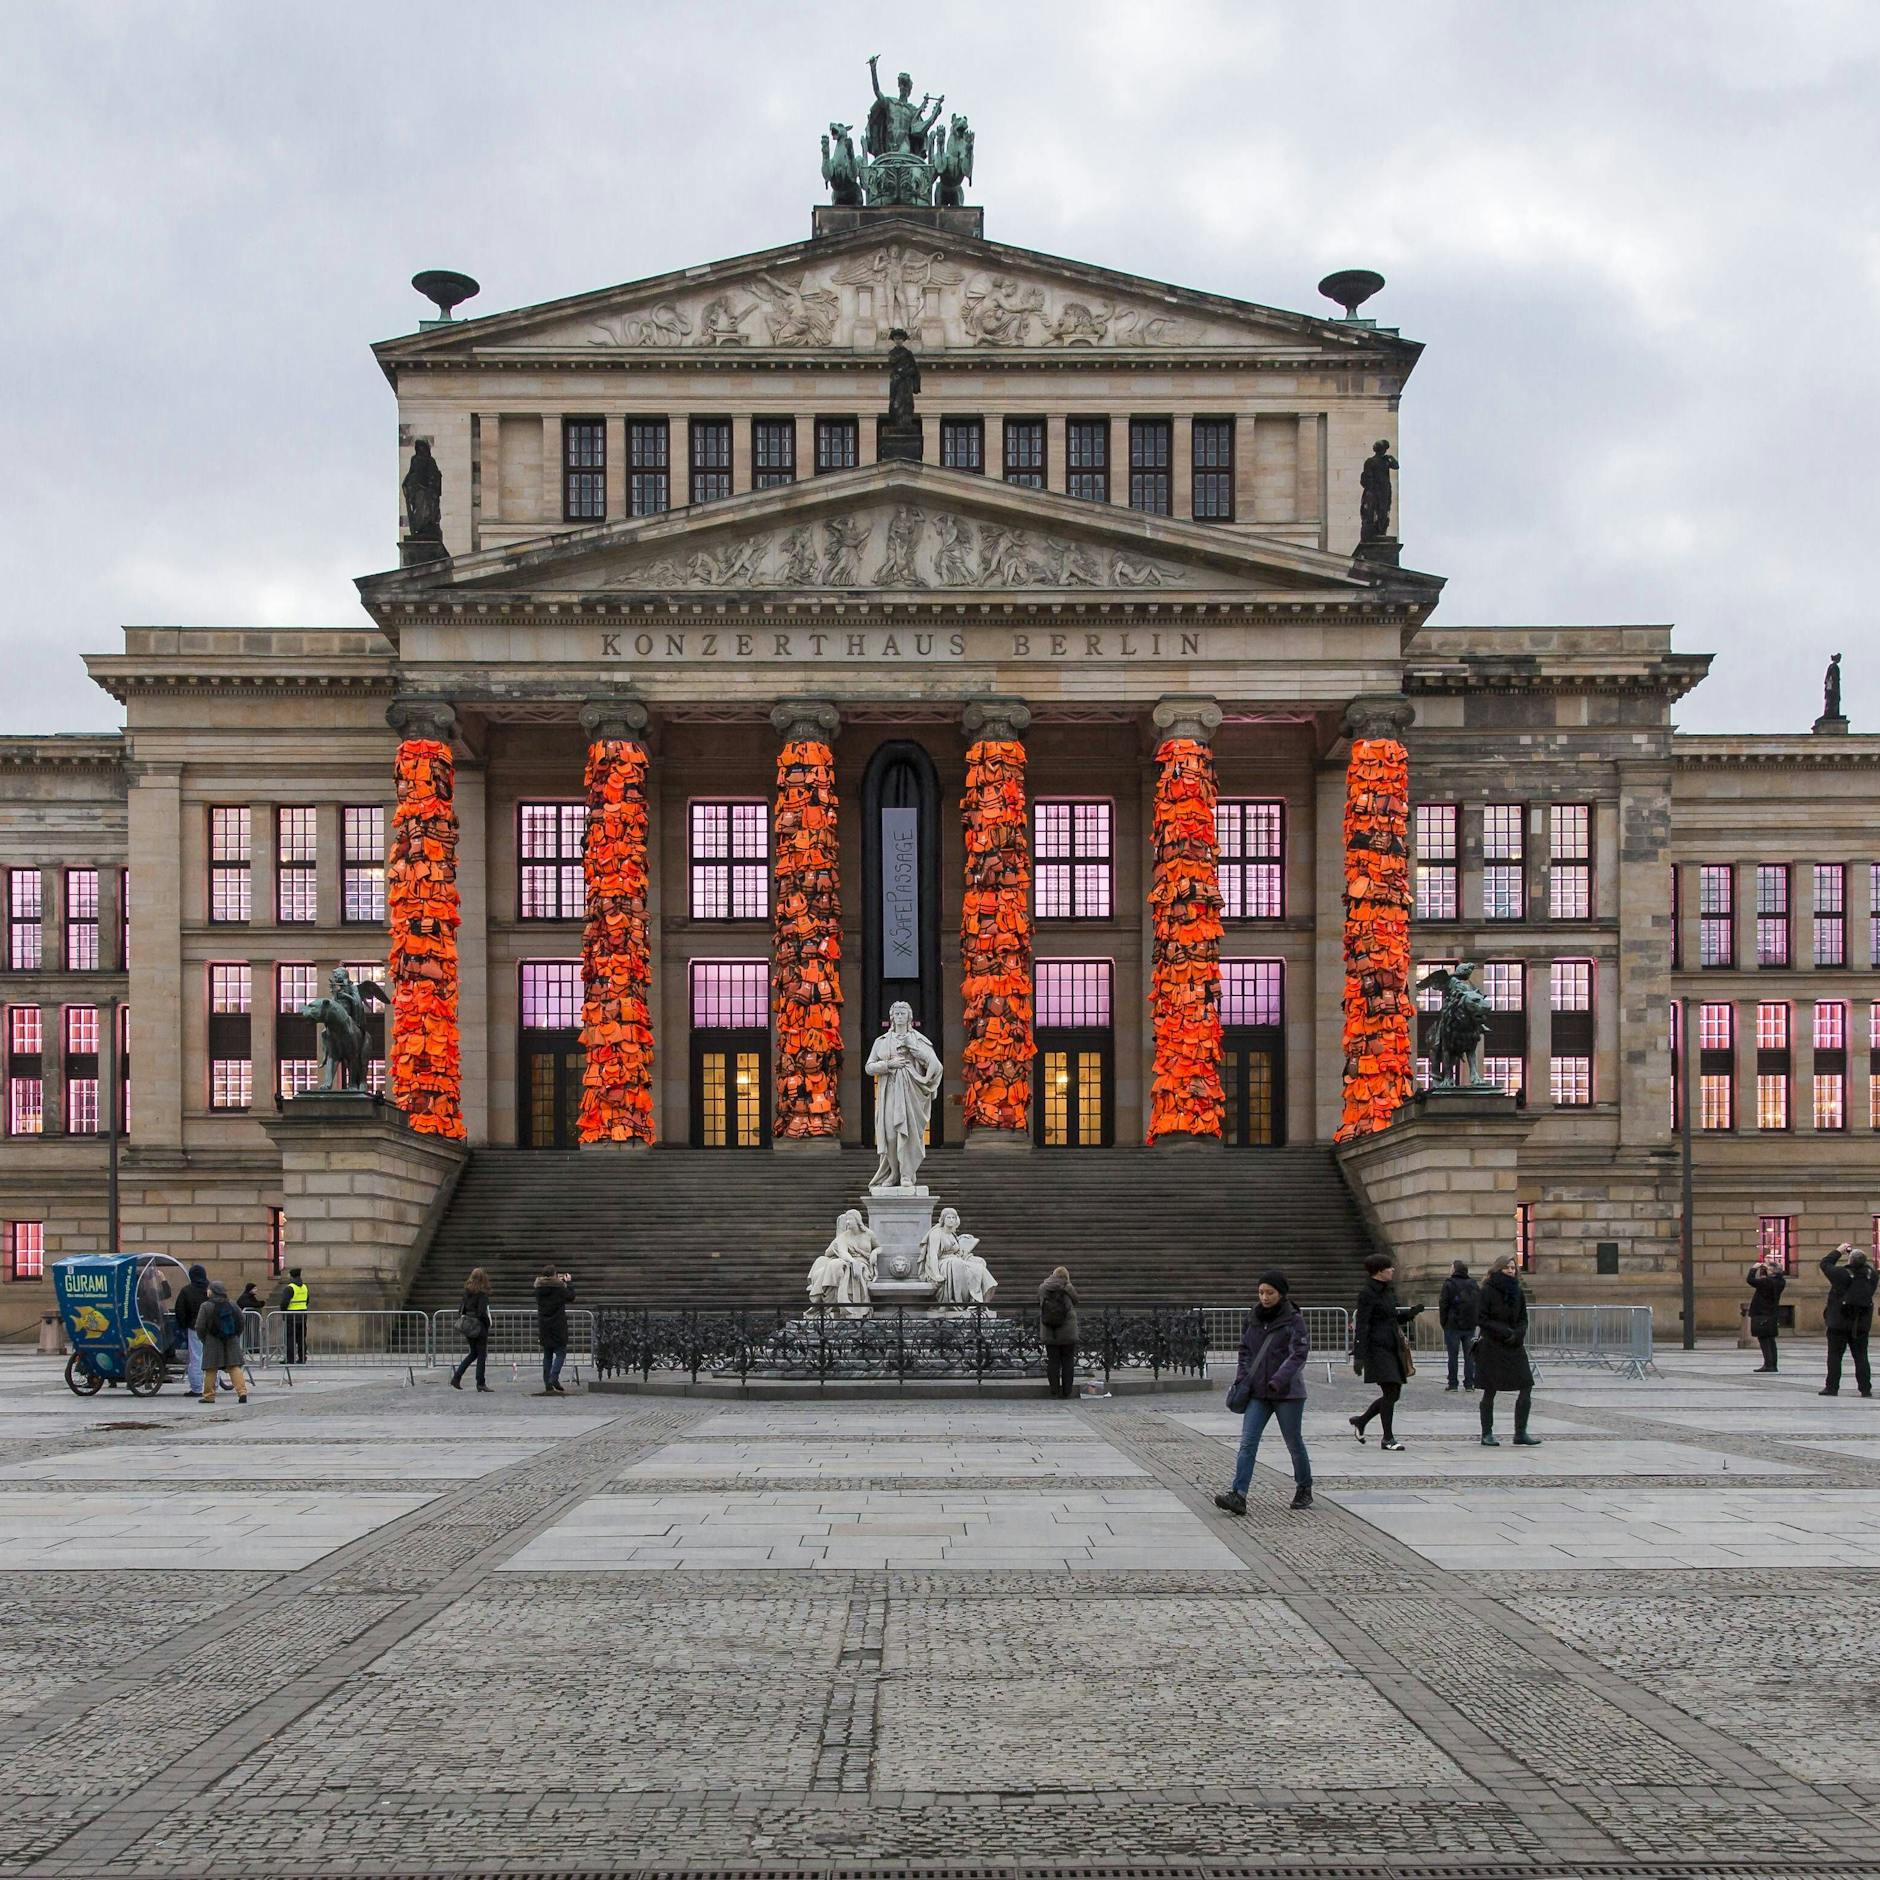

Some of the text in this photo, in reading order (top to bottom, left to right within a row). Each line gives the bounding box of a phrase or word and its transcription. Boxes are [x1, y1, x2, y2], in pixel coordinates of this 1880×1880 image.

[601, 633, 1201, 656] KONZERTHAUS BERLIN
[64, 1274, 108, 1292] GURAMI
